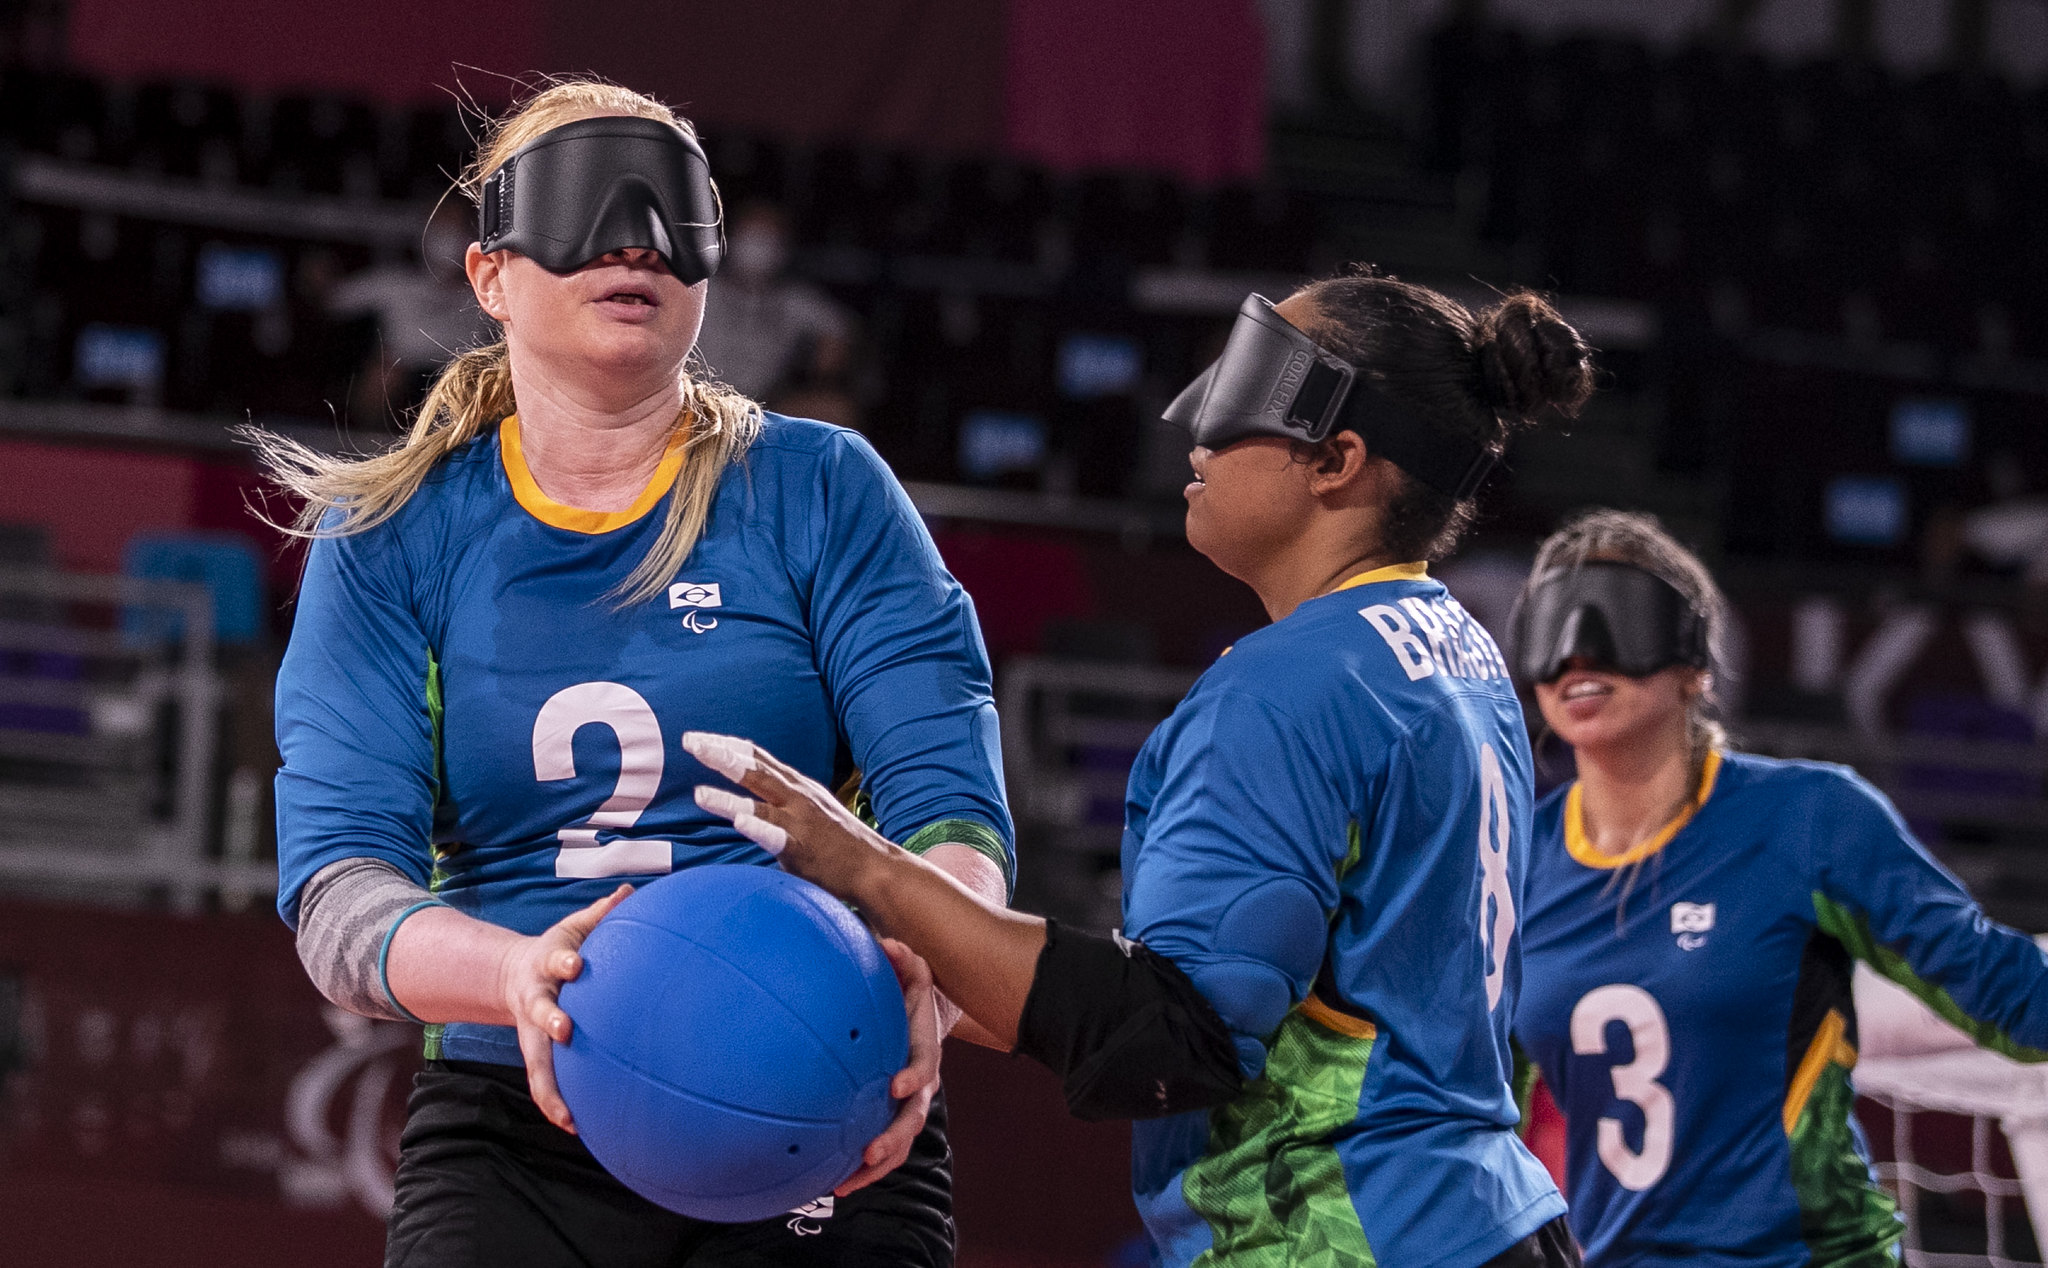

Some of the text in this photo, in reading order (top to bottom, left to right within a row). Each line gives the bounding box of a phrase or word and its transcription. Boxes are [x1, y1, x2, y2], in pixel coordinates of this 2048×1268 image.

[1266, 350, 1310, 418] GOALFIX
[532, 681, 672, 879] 2
[1478, 742, 1516, 1013] 8
[1570, 983, 1676, 1192] 3
